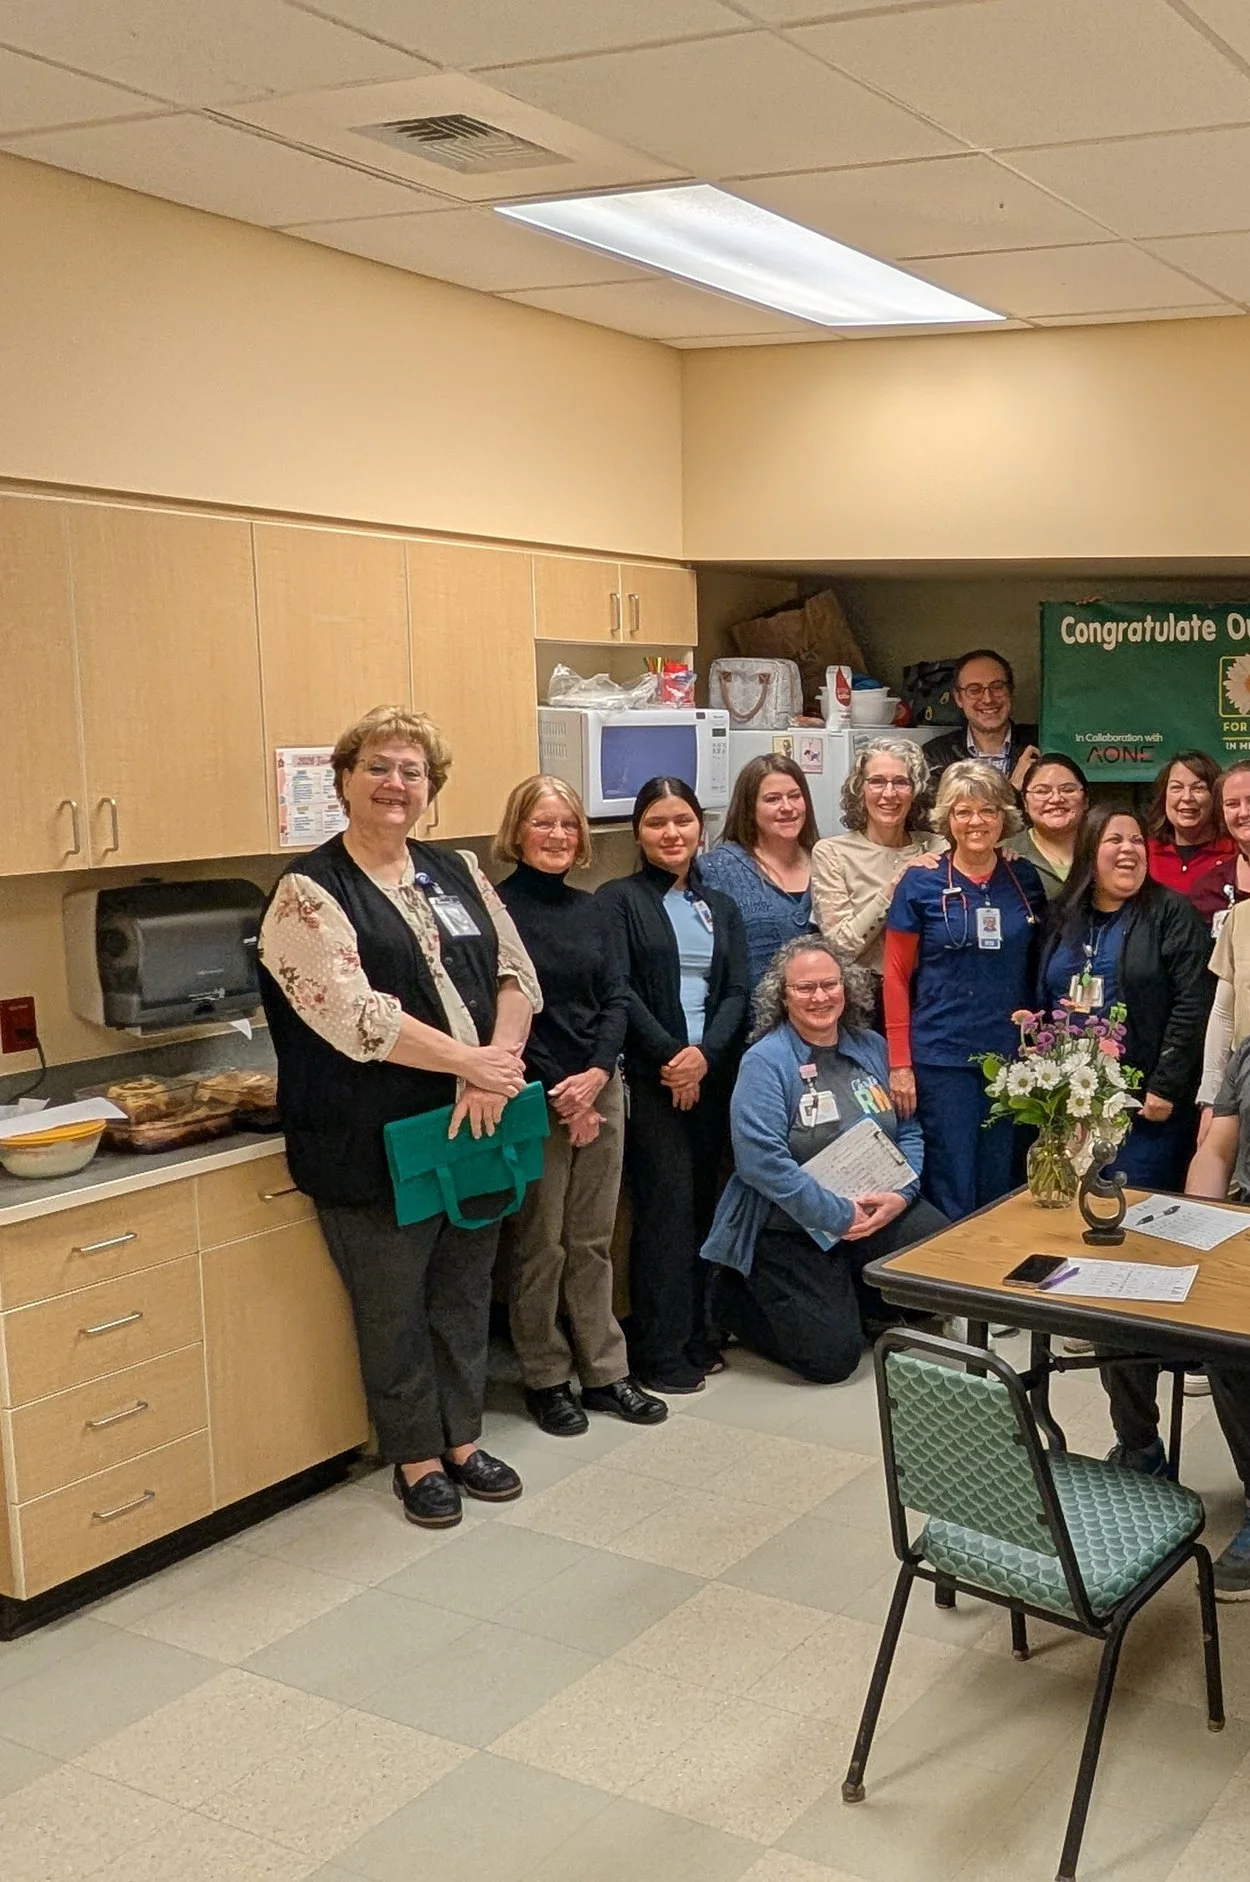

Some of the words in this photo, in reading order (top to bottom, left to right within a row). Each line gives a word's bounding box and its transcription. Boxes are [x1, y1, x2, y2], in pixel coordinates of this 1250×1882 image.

[1061, 613, 1217, 651] Congratulate
[1223, 722, 1247, 732] FOR
[1075, 733, 1084, 742] In
[1085, 733, 1143, 742] Collaboration
[1144, 733, 1163, 742] with
[1225, 741, 1237, 750] IN
[1086, 746, 1154, 763] AONE
[853, 1084, 893, 1114] RN
